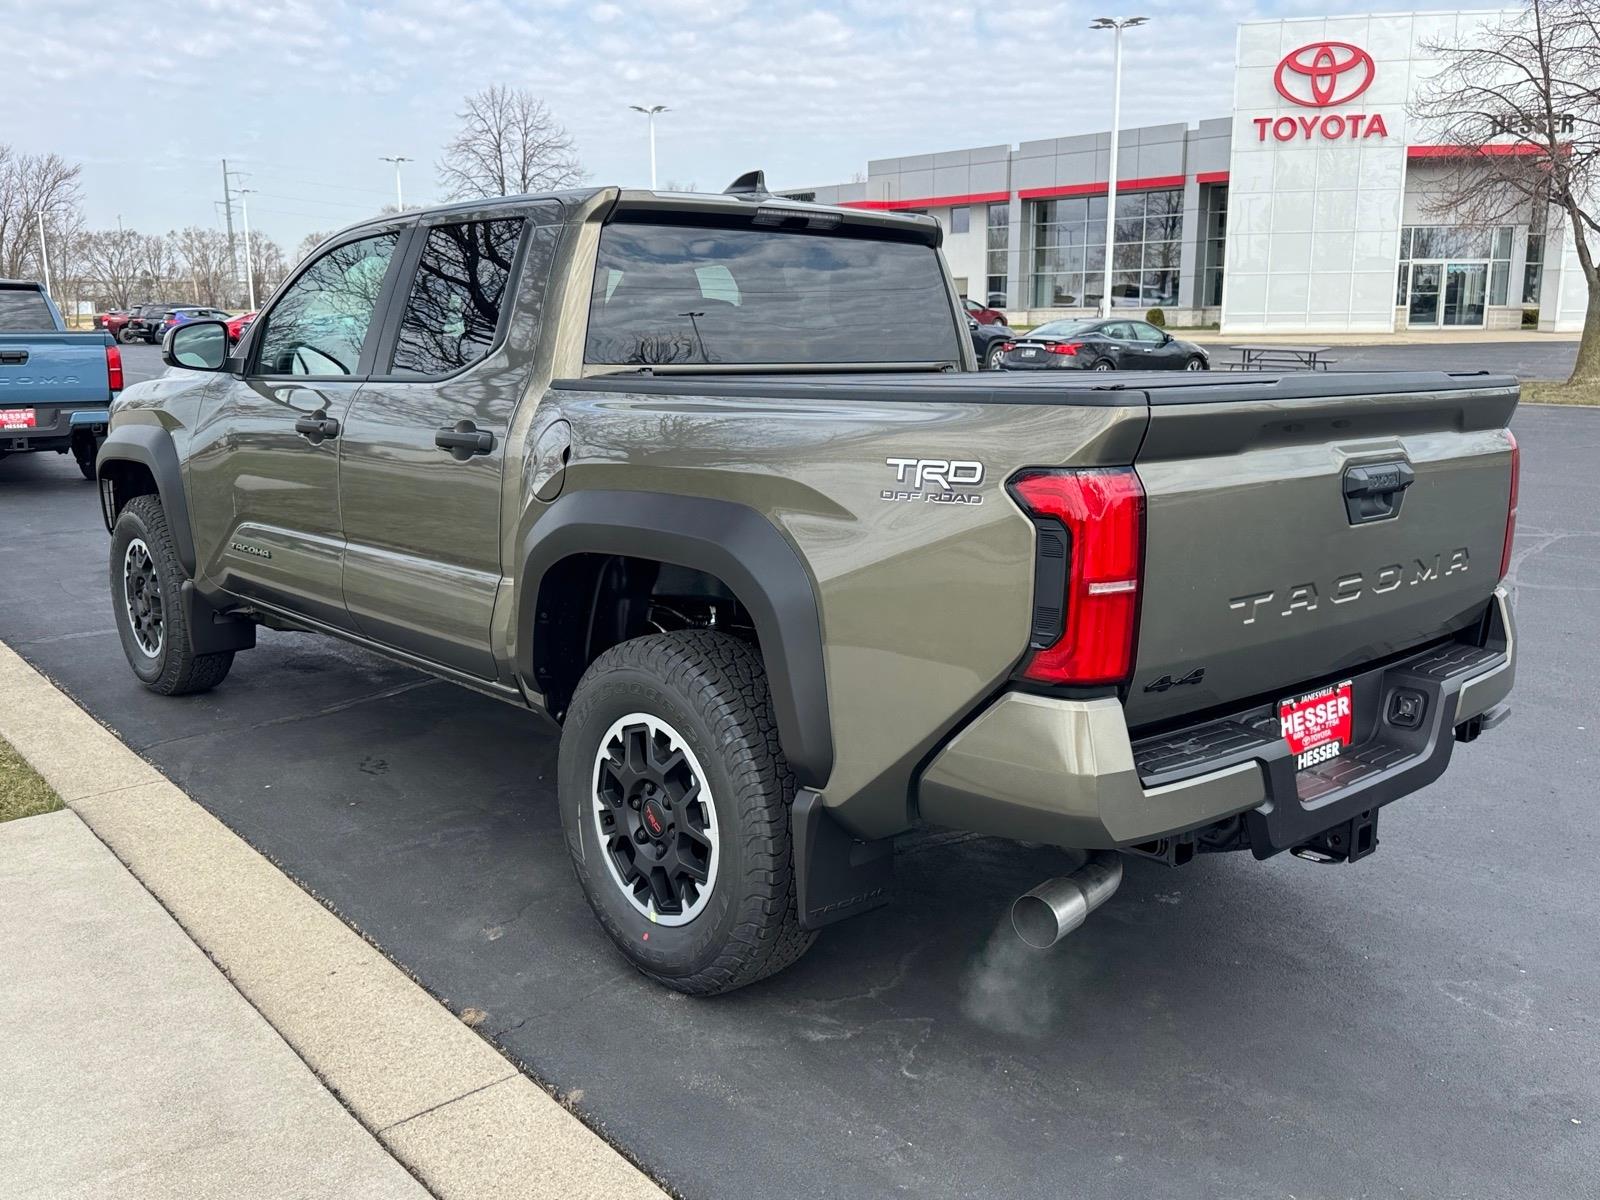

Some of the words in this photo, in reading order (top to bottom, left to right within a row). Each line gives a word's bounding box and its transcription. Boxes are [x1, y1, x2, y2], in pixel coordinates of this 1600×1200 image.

[1253, 114, 1388, 142] TOYOTA
[886, 457, 985, 491] TRD
[880, 489, 922, 502] OFF
[925, 491, 984, 506] ROAD
[231, 542, 271, 559] TACOMA
[1229, 547, 1470, 625] TACOMA
[1300, 686, 1333, 704] JANESVILLE
[1281, 696, 1350, 738] HESSER
[1310, 729, 1332, 743] TOYOTA
[1297, 741, 1340, 770] HESSER
[646, 804, 661, 832] TRD
